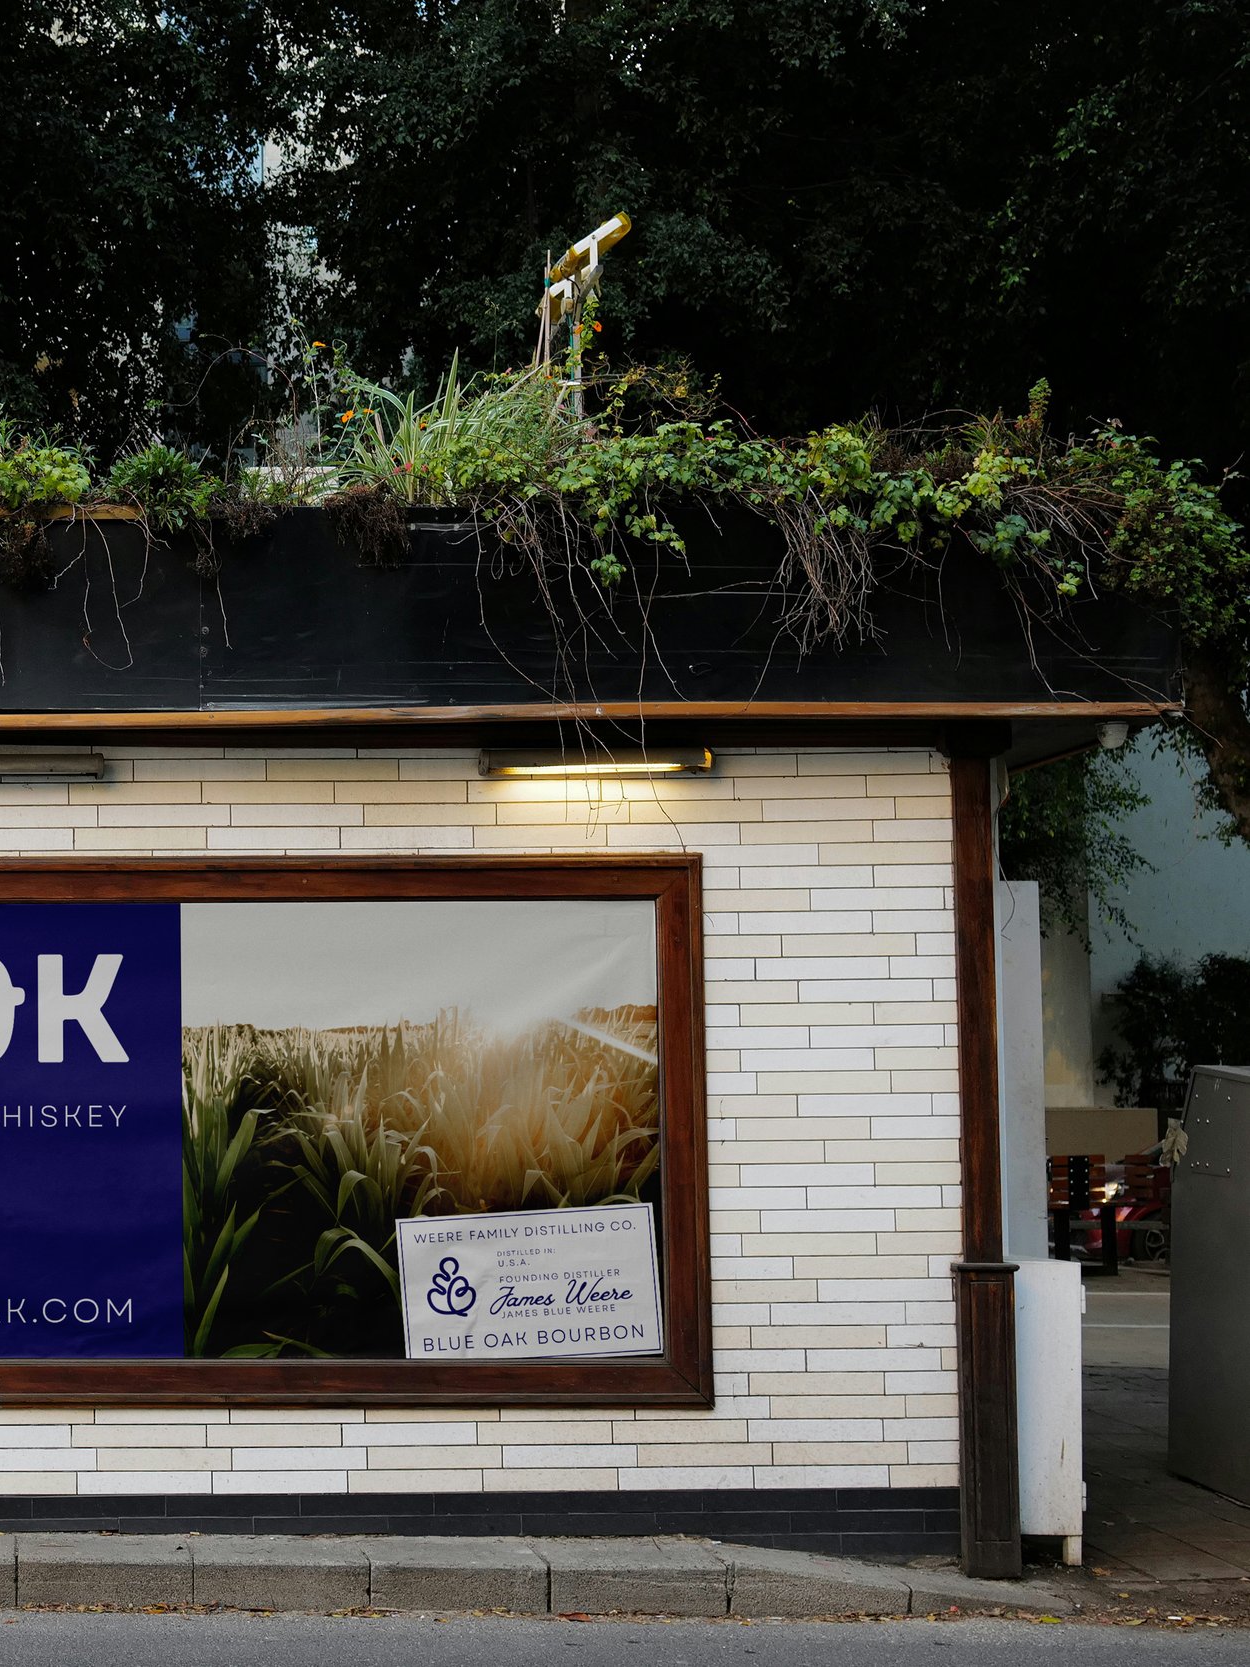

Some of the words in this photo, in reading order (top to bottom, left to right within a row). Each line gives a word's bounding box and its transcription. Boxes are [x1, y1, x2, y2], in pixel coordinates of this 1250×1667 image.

[414, 1231, 464, 1244] WEERE
[469, 1227, 519, 1241] FAMILY
[524, 1223, 605, 1237] DISTILLING
[610, 1219, 636, 1232] CO.
[496, 1248, 541, 1257] DISTILLED
[497, 1258, 531, 1267] U.S.A.
[499, 1272, 559, 1283] FOUNDING
[563, 1268, 620, 1279] DISTILLER
[489, 1286, 555, 1315] James
[566, 1278, 633, 1305] Weere
[501, 1309, 538, 1319] JAMES
[543, 1307, 572, 1317] BLUE
[576, 1304, 616, 1314] WEERE
[423, 1334, 475, 1352] BLUE
[483, 1331, 528, 1349] OAK
[537, 1324, 645, 1345] BOURBON
